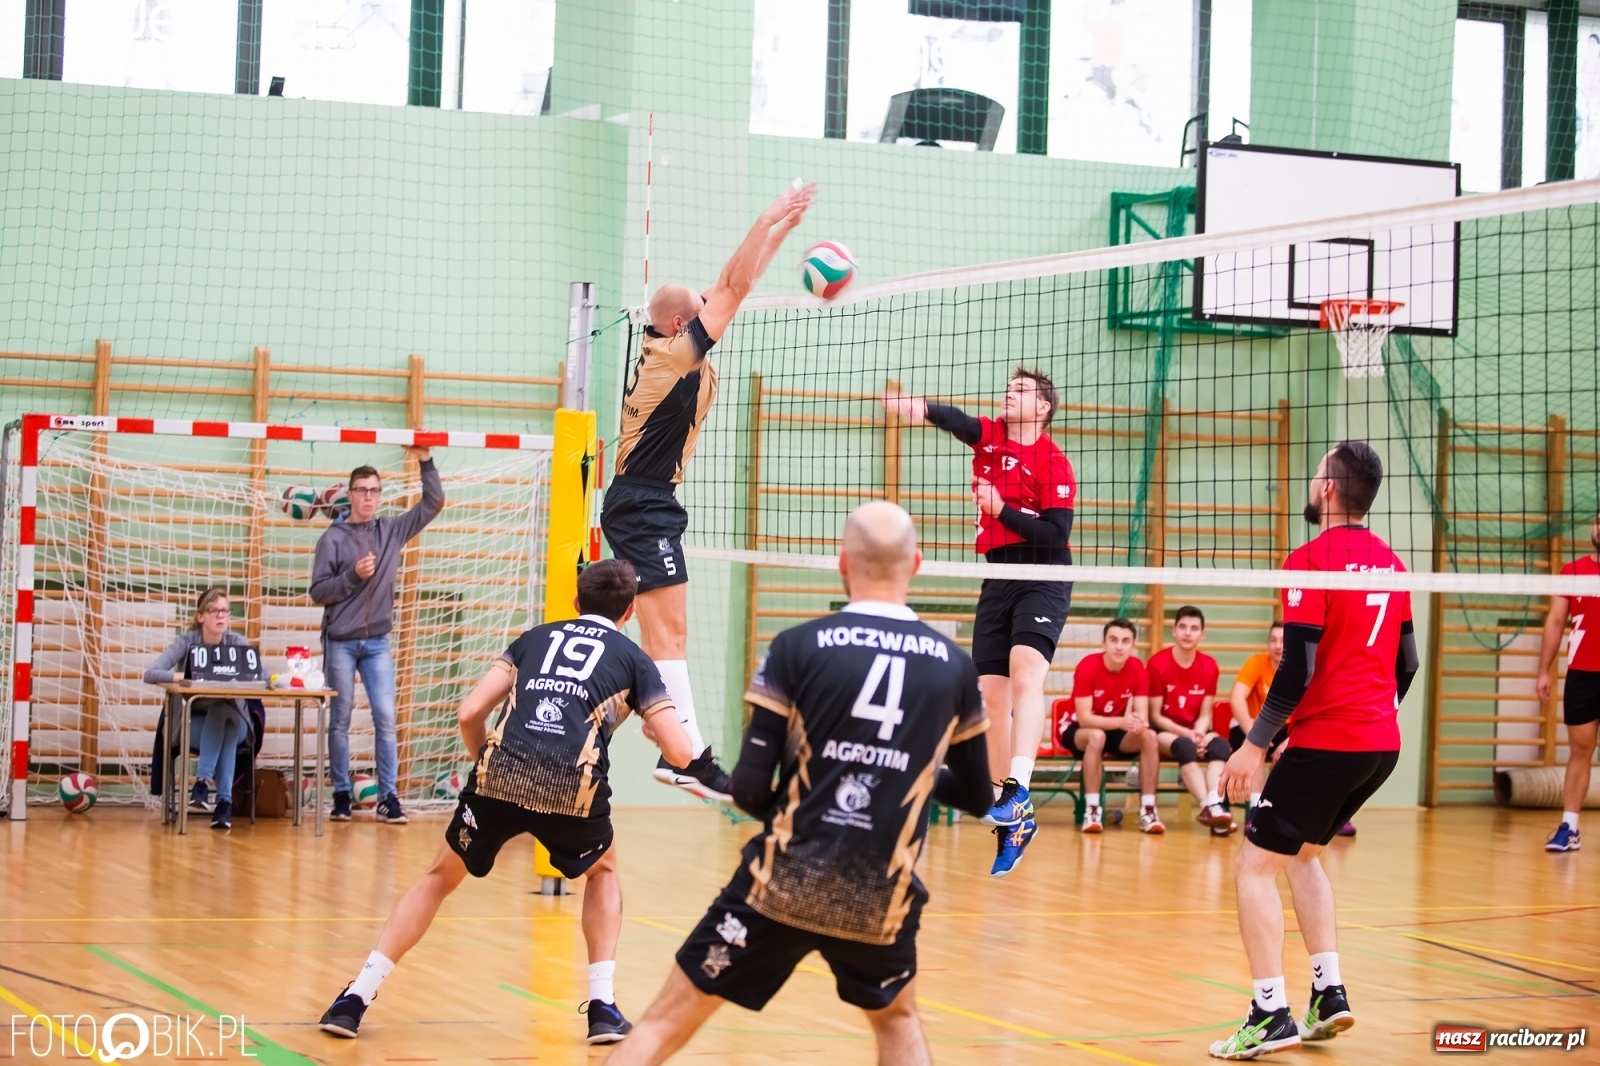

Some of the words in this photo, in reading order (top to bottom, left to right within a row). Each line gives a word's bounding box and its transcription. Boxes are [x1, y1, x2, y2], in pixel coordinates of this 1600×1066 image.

[81, 420, 105, 428] sport
[663, 555, 677, 576] 5
[563, 623, 608, 638] BART
[1365, 592, 1391, 648] 7
[540, 630, 606, 682] 19
[816, 626, 949, 662] KOCZWARA
[191, 646, 208, 669] 10
[214, 647, 221, 661] 1
[228, 647, 237, 662] 0
[246, 648, 258, 670] 9
[524, 677, 589, 701] AGROTIM
[850, 652, 906, 742] 4
[1103, 700, 1114, 714] 6
[821, 739, 911, 773] AGROTIM
